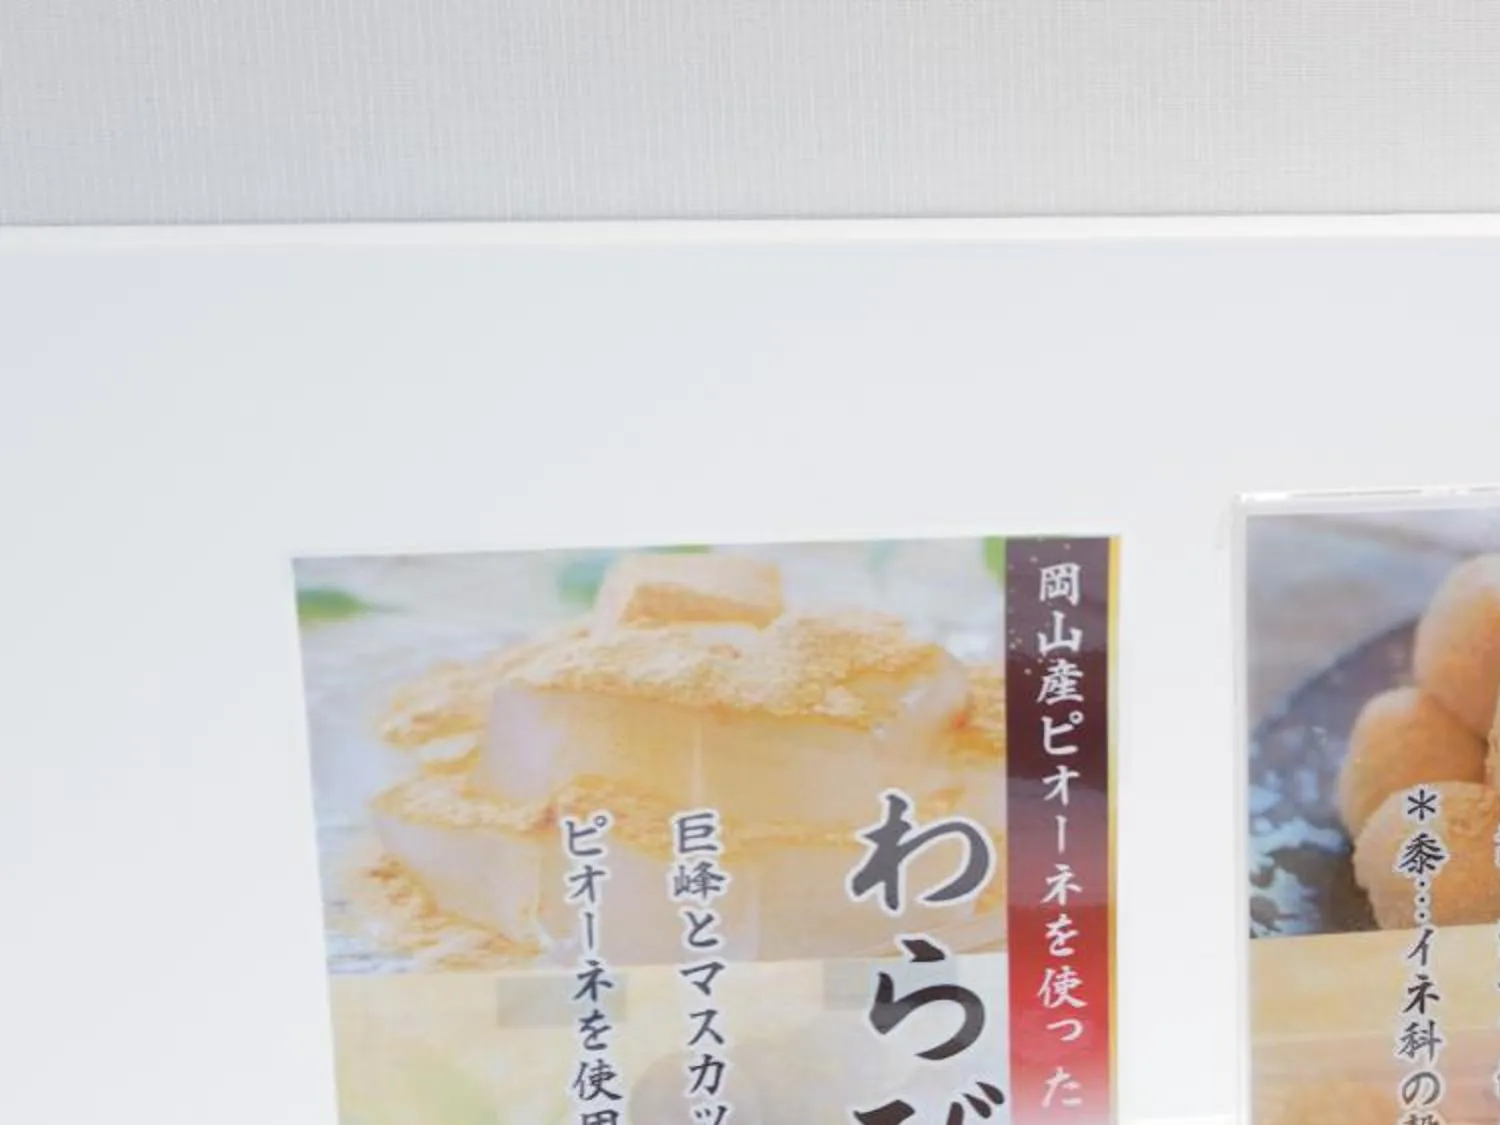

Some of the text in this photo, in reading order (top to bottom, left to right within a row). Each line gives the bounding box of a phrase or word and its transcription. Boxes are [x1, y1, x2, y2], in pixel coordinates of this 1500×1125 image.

[1036, 562, 1086, 1109] 岡山産ピオーネを使った
